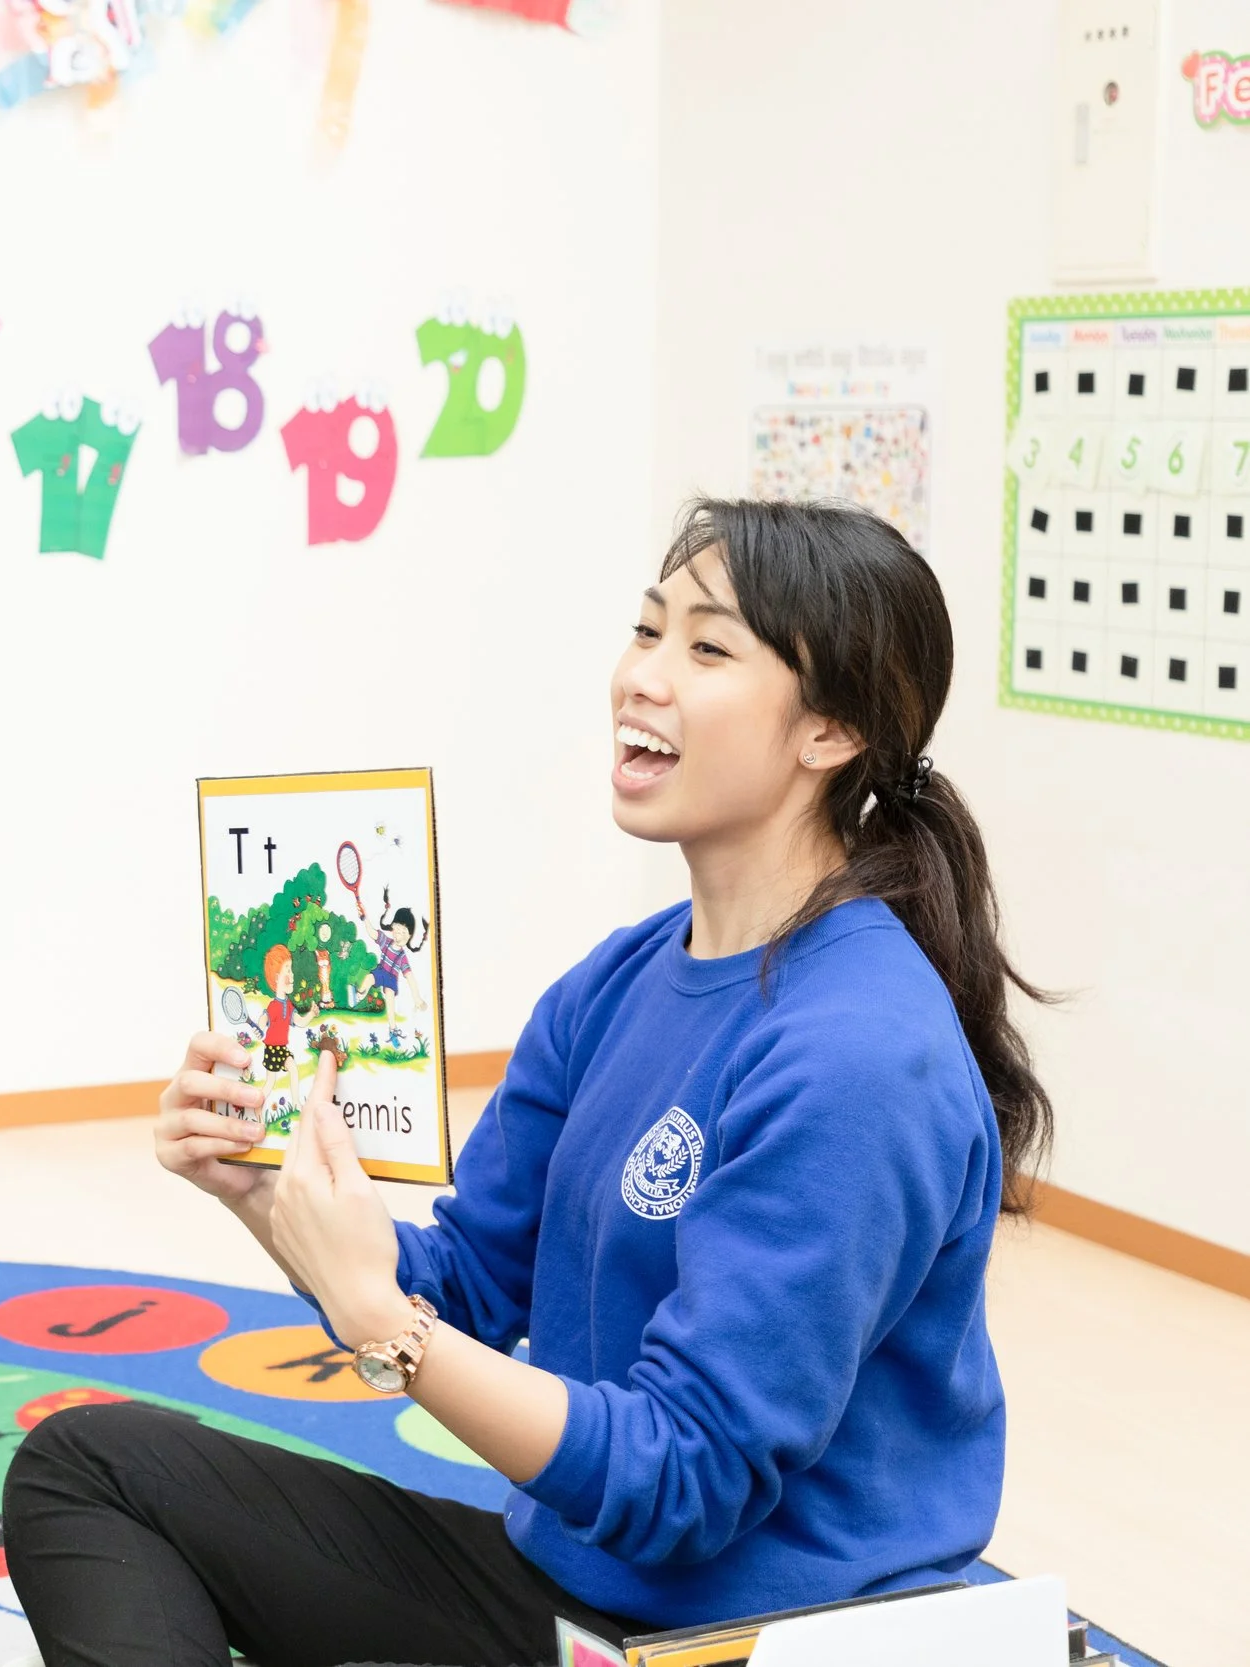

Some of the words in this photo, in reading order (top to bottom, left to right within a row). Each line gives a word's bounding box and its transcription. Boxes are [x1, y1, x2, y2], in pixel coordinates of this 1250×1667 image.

[147, 305, 267, 456] 18
[415, 308, 527, 458] 20
[10, 395, 143, 560] 17
[279, 393, 399, 546] 19
[1023, 437, 1041, 468] 3
[1068, 437, 1085, 470] 4
[1121, 437, 1141, 470] 5
[1168, 441, 1184, 475] 6
[1233, 440, 1250, 476] 7
[228, 827, 249, 874] T
[263, 836, 277, 874] t
